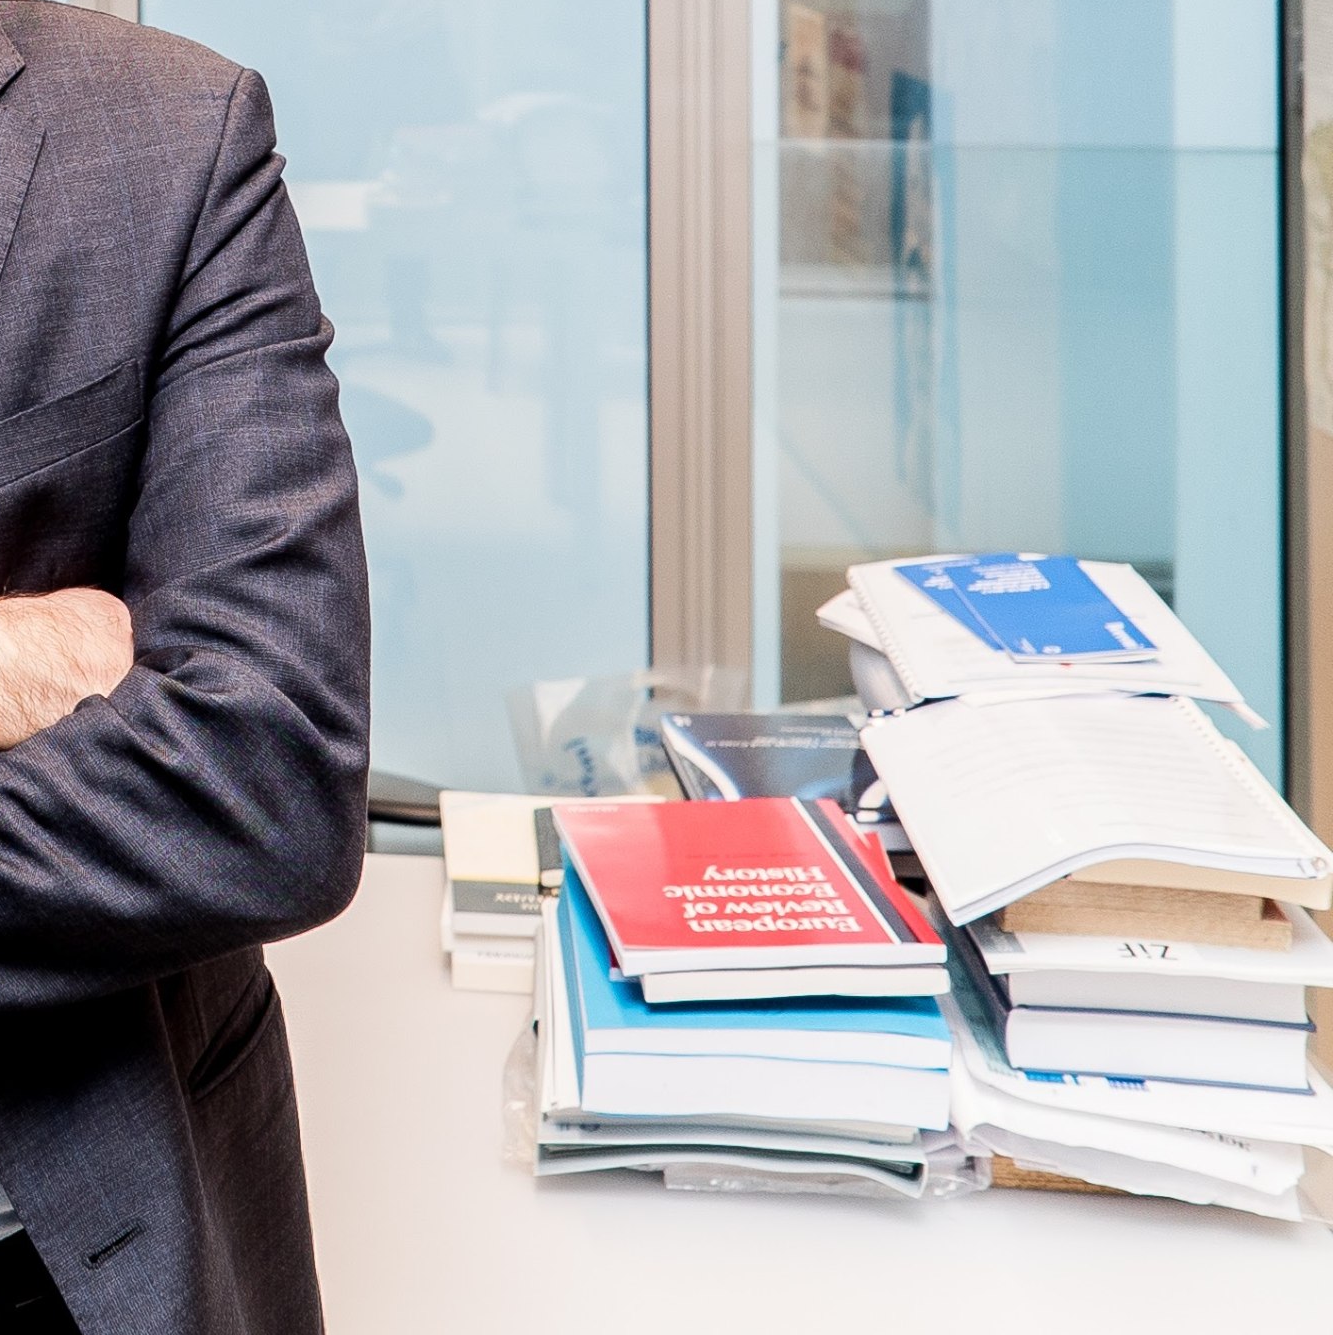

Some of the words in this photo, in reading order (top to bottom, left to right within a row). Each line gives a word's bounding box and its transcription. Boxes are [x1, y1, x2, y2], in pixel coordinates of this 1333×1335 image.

[702, 865, 825, 882] History
[662, 883, 838, 901] Economic
[684, 901, 718, 918] of
[725, 899, 851, 917] Review
[687, 915, 862, 934] European
